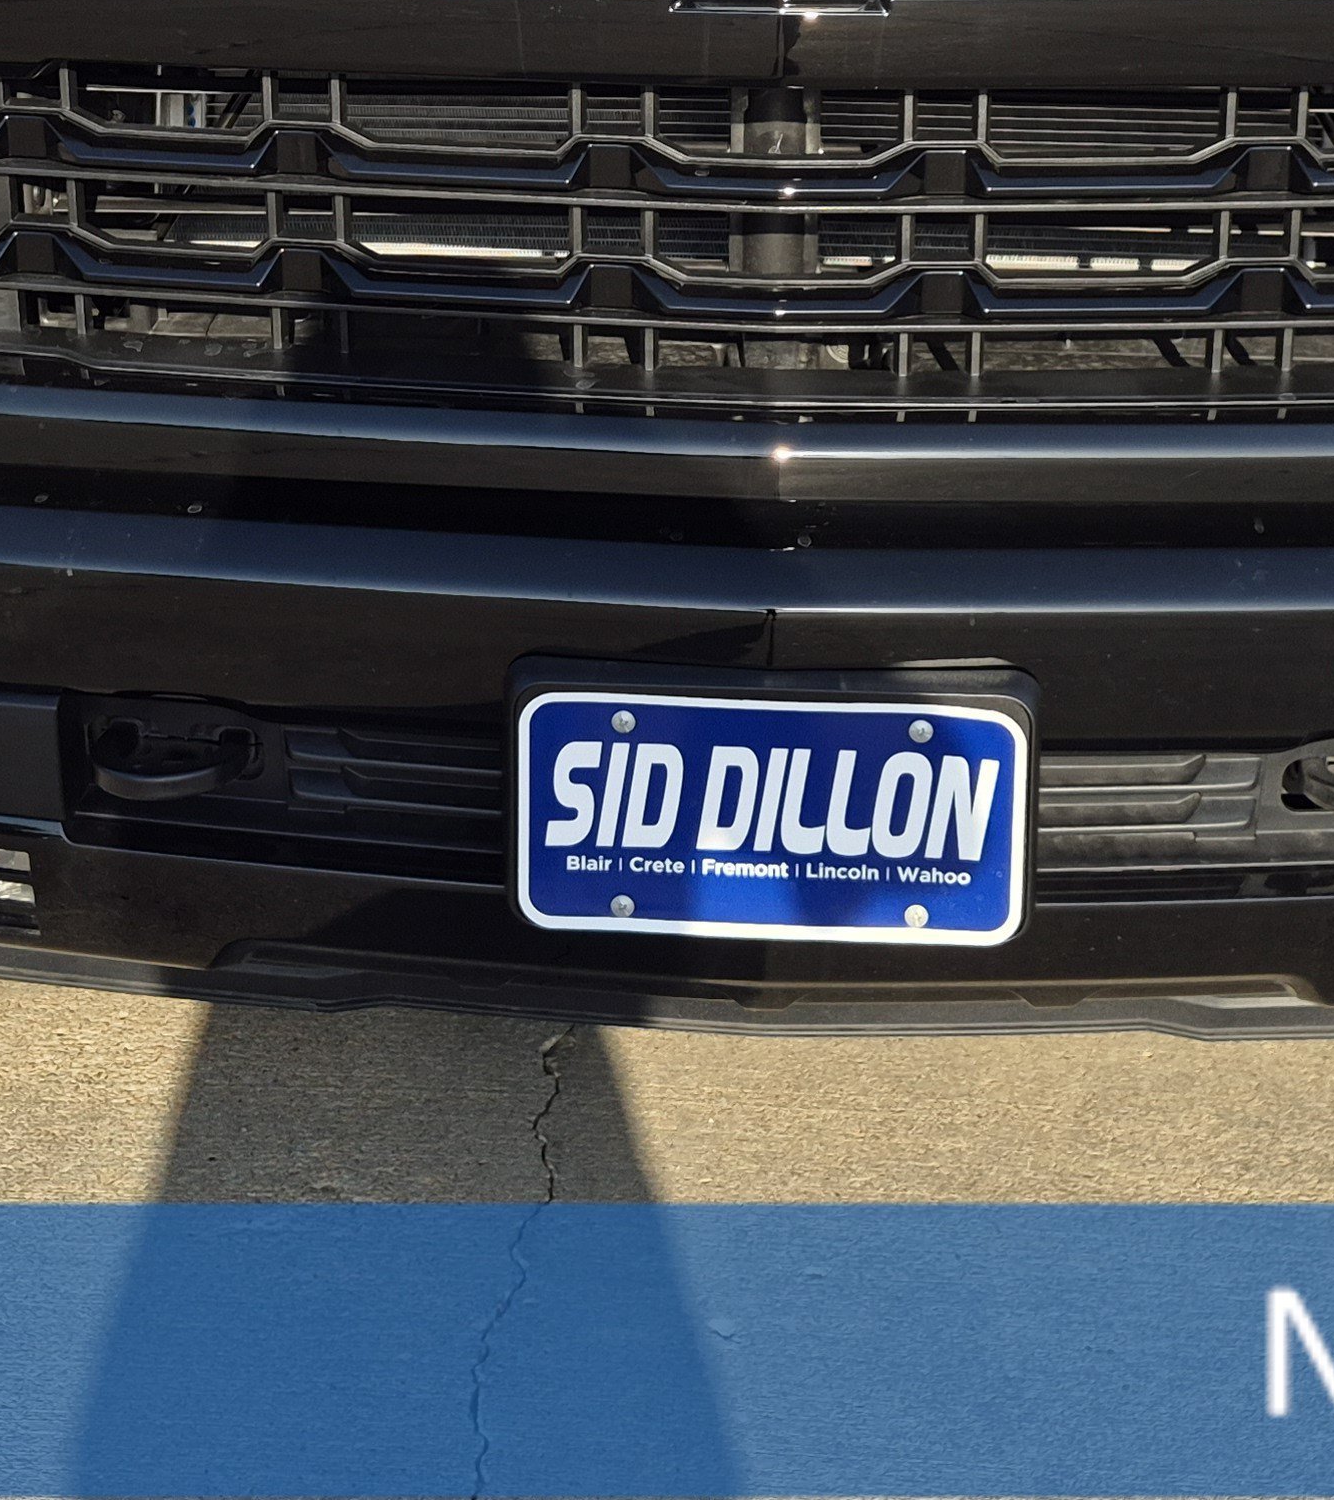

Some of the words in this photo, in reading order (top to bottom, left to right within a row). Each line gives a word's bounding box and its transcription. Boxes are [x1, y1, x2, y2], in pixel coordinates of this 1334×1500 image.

[544, 741, 684, 848] SID
[695, 745, 1001, 862] DILLON
[566, 855, 613, 872] Blair
[629, 856, 686, 874] Crete
[701, 858, 790, 879] Fremont
[805, 862, 880, 881] Lincoln
[896, 866, 972, 886] Wahoo
